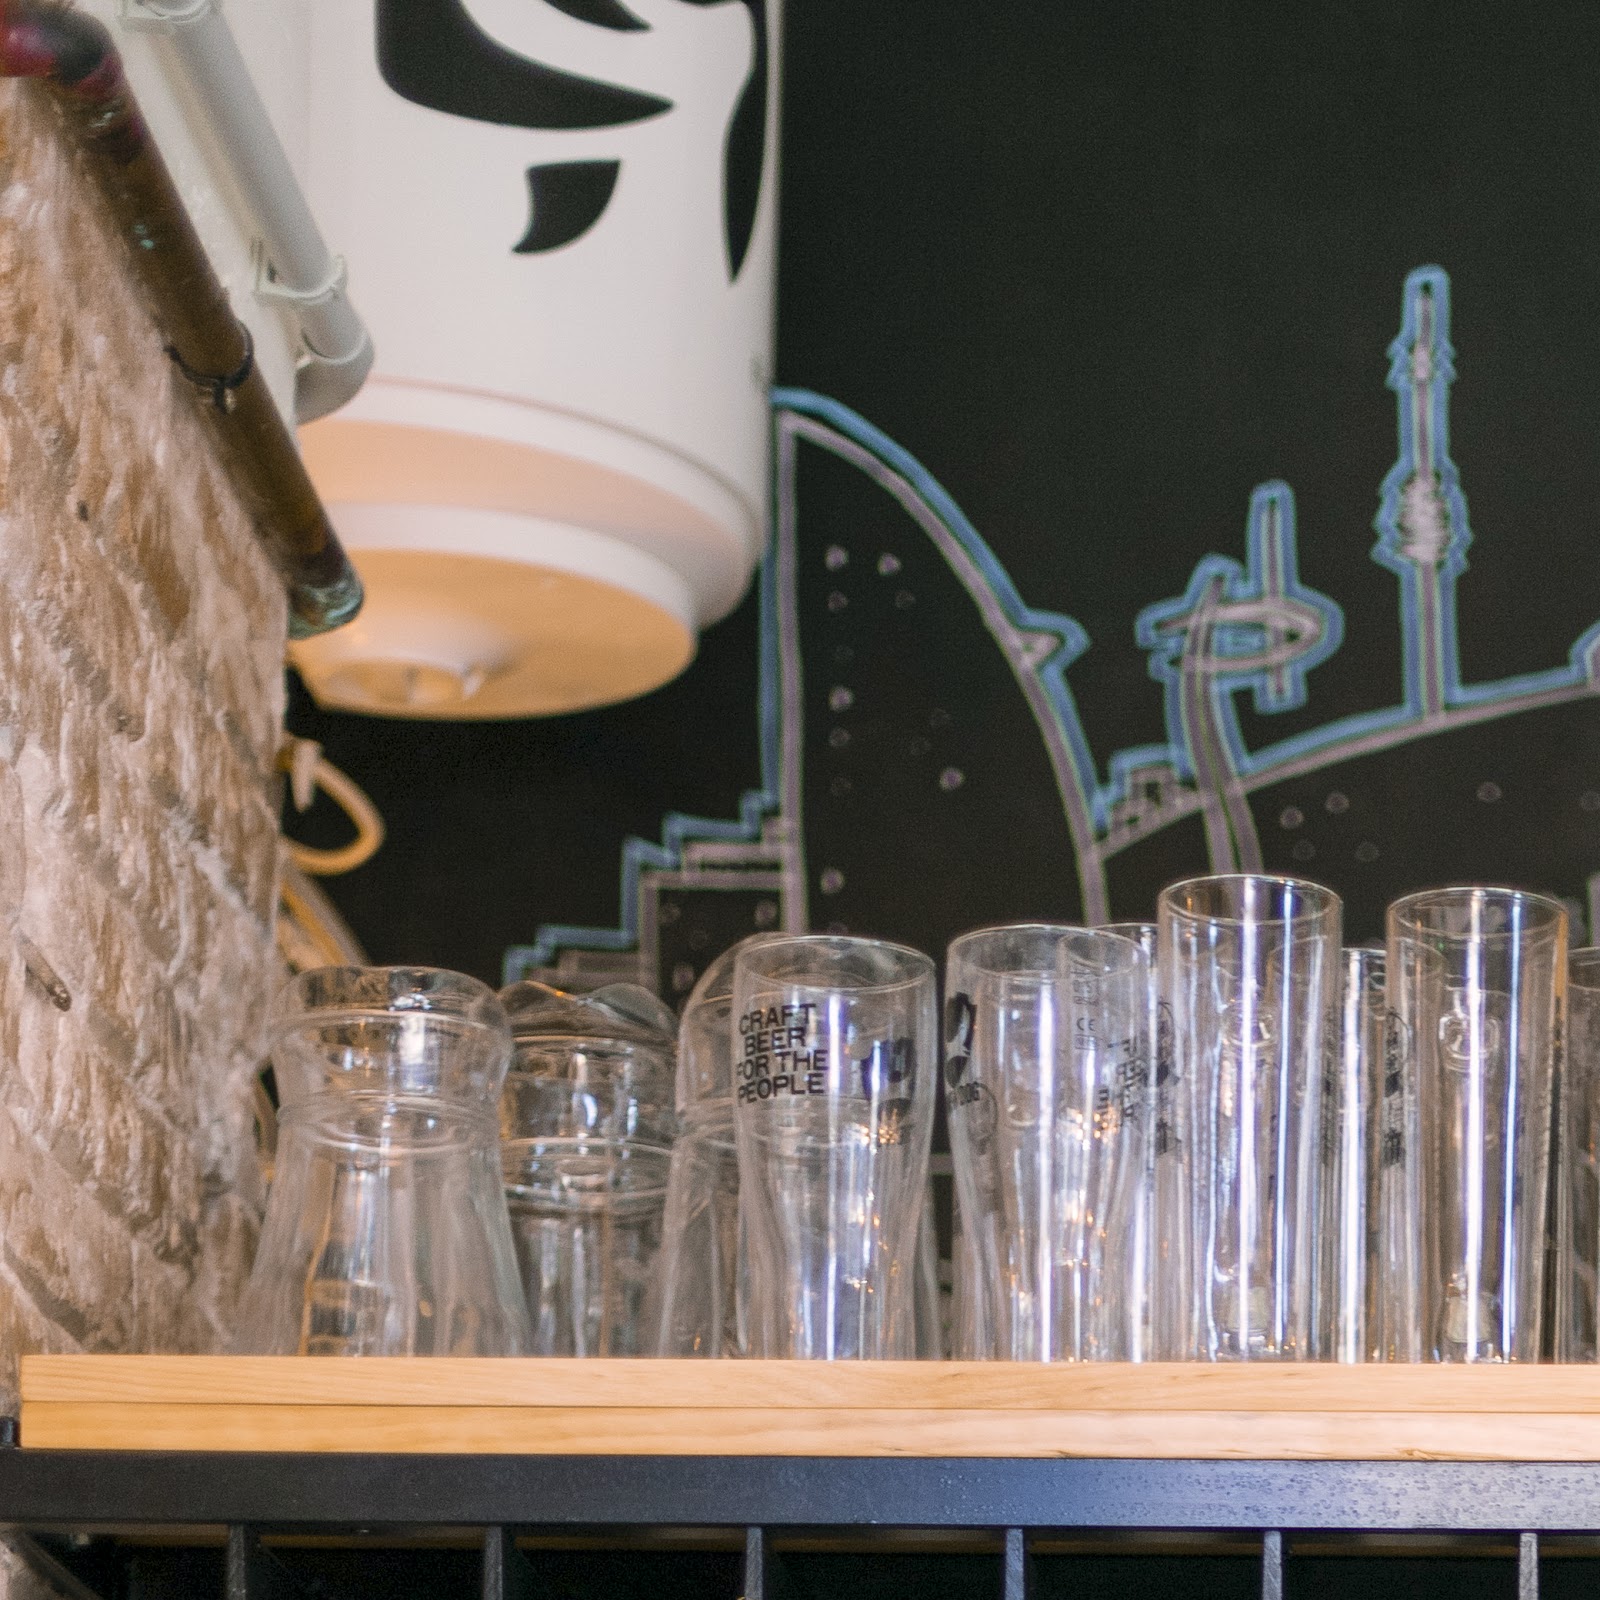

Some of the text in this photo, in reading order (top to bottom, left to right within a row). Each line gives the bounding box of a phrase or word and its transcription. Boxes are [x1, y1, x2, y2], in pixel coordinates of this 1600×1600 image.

[739, 1003, 816, 1036] CRAFT
[745, 1027, 806, 1057] BEER
[774, 1049, 829, 1073] THE
[738, 1073, 825, 1105] PEOPLE
